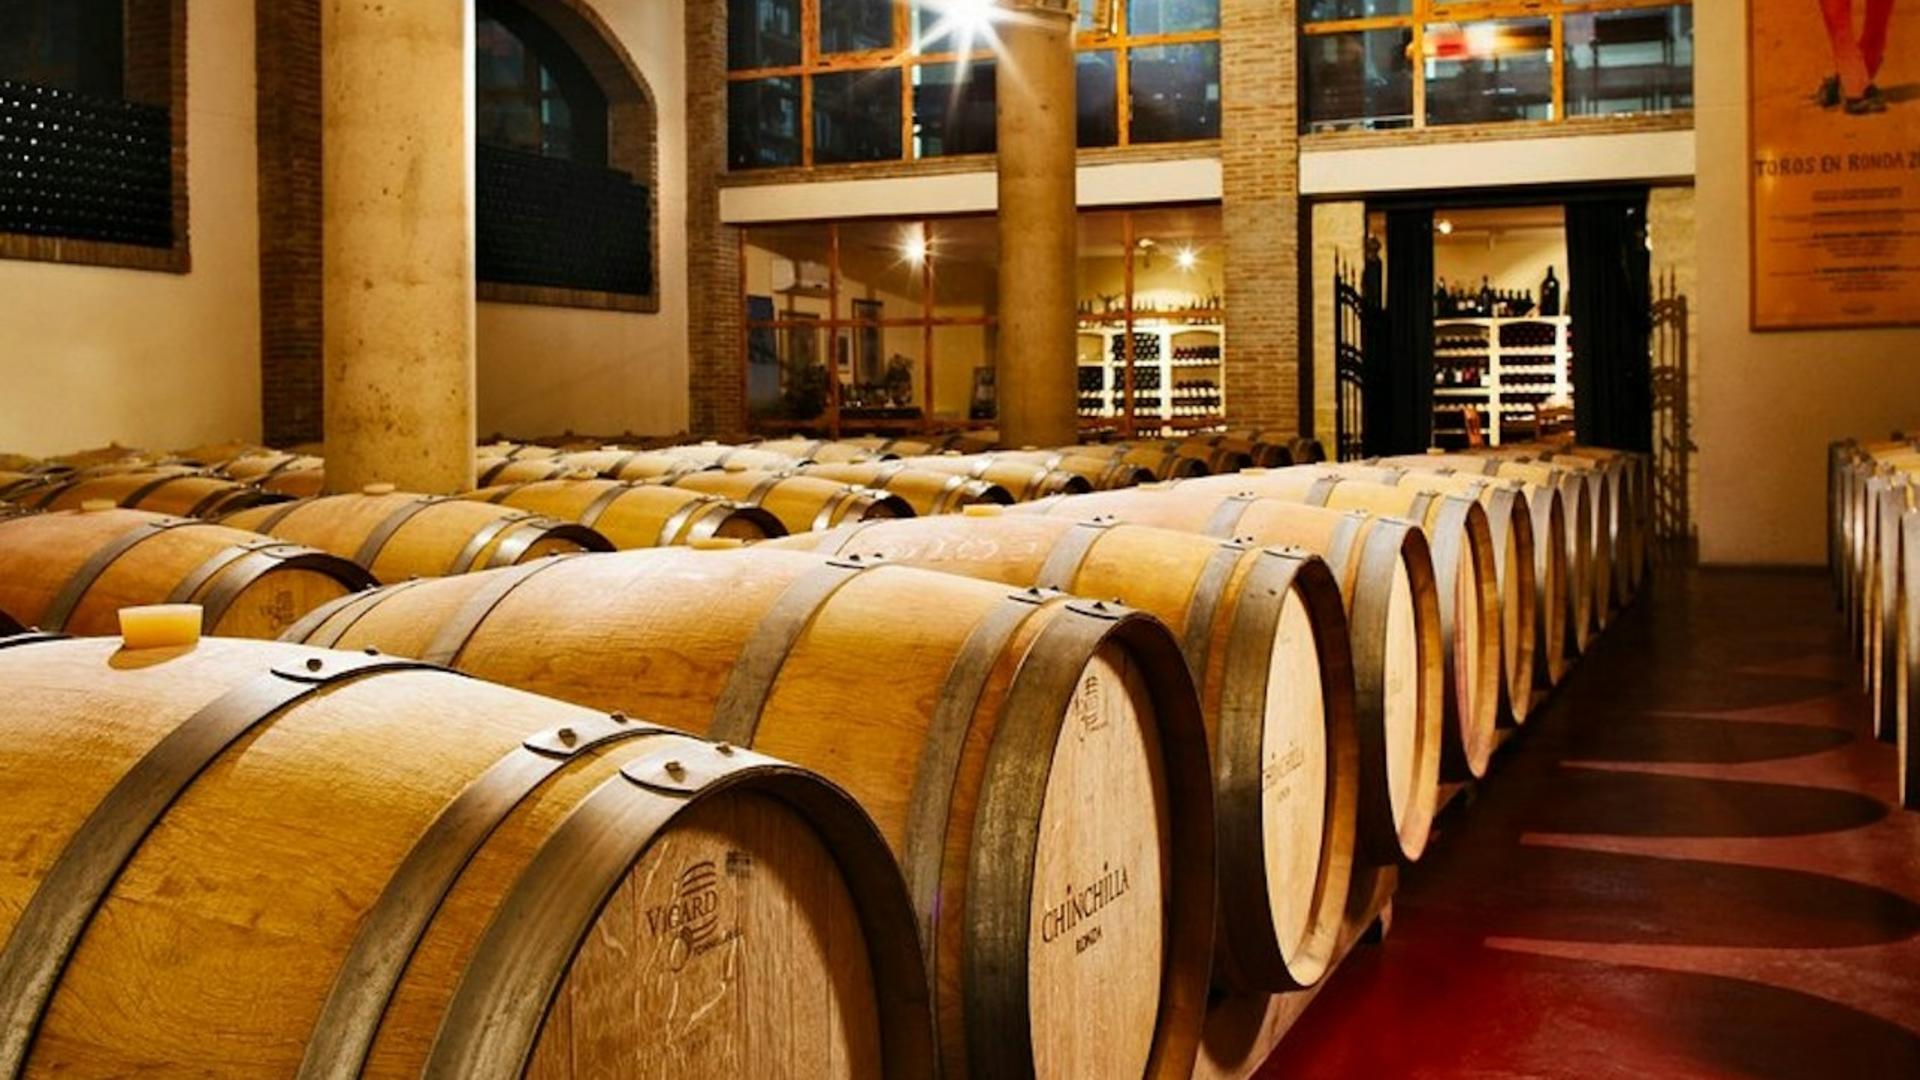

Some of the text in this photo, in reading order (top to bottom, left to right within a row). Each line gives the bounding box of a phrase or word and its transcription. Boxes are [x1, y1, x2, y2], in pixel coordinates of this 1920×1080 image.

[1754, 156, 1816, 176] TOROS
[1821, 154, 1841, 174] EN
[1848, 152, 1904, 171] RONDA
[645, 890, 718, 937] VICARD
[1042, 861, 1129, 943] CHINCHILLA
